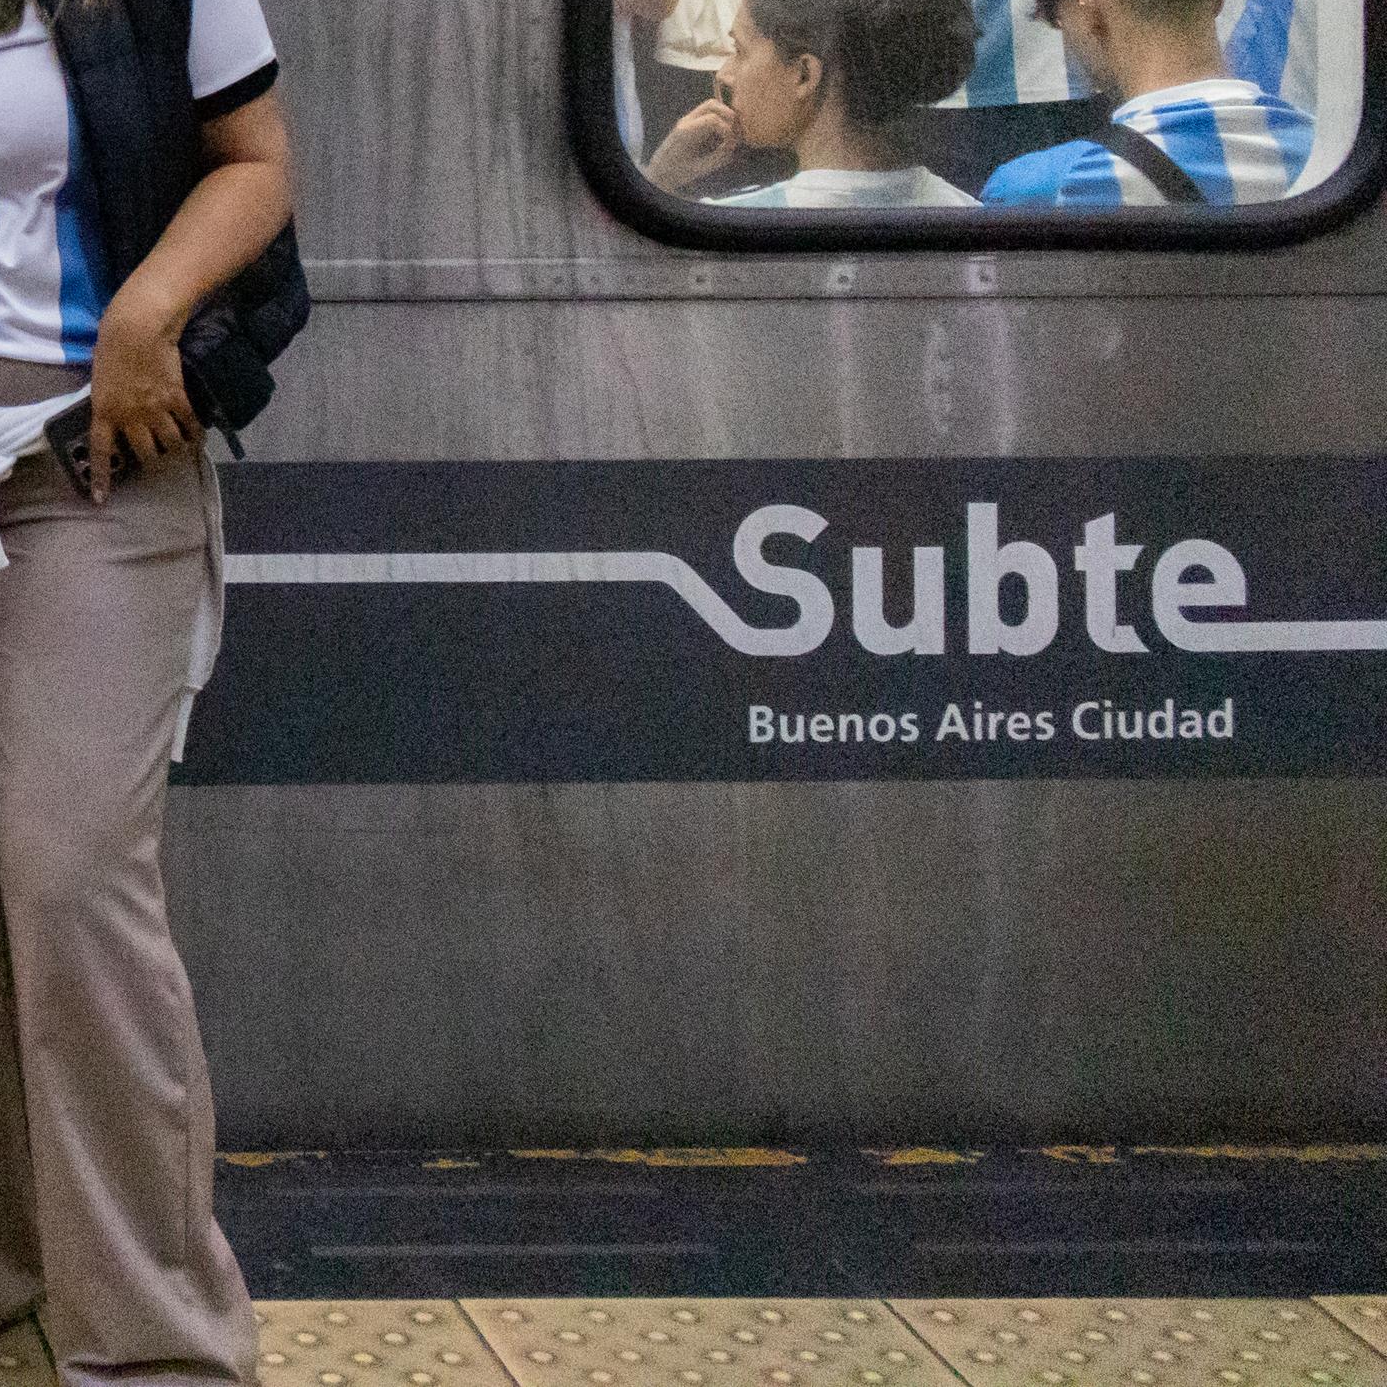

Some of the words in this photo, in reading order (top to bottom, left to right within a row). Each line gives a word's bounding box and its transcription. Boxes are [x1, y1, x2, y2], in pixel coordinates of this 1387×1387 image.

[722, 501, 1247, 657] Subte
[748, 705, 919, 743] Buenos
[935, 701, 1056, 742] Aires
[1071, 698, 1235, 741] Ciudad
